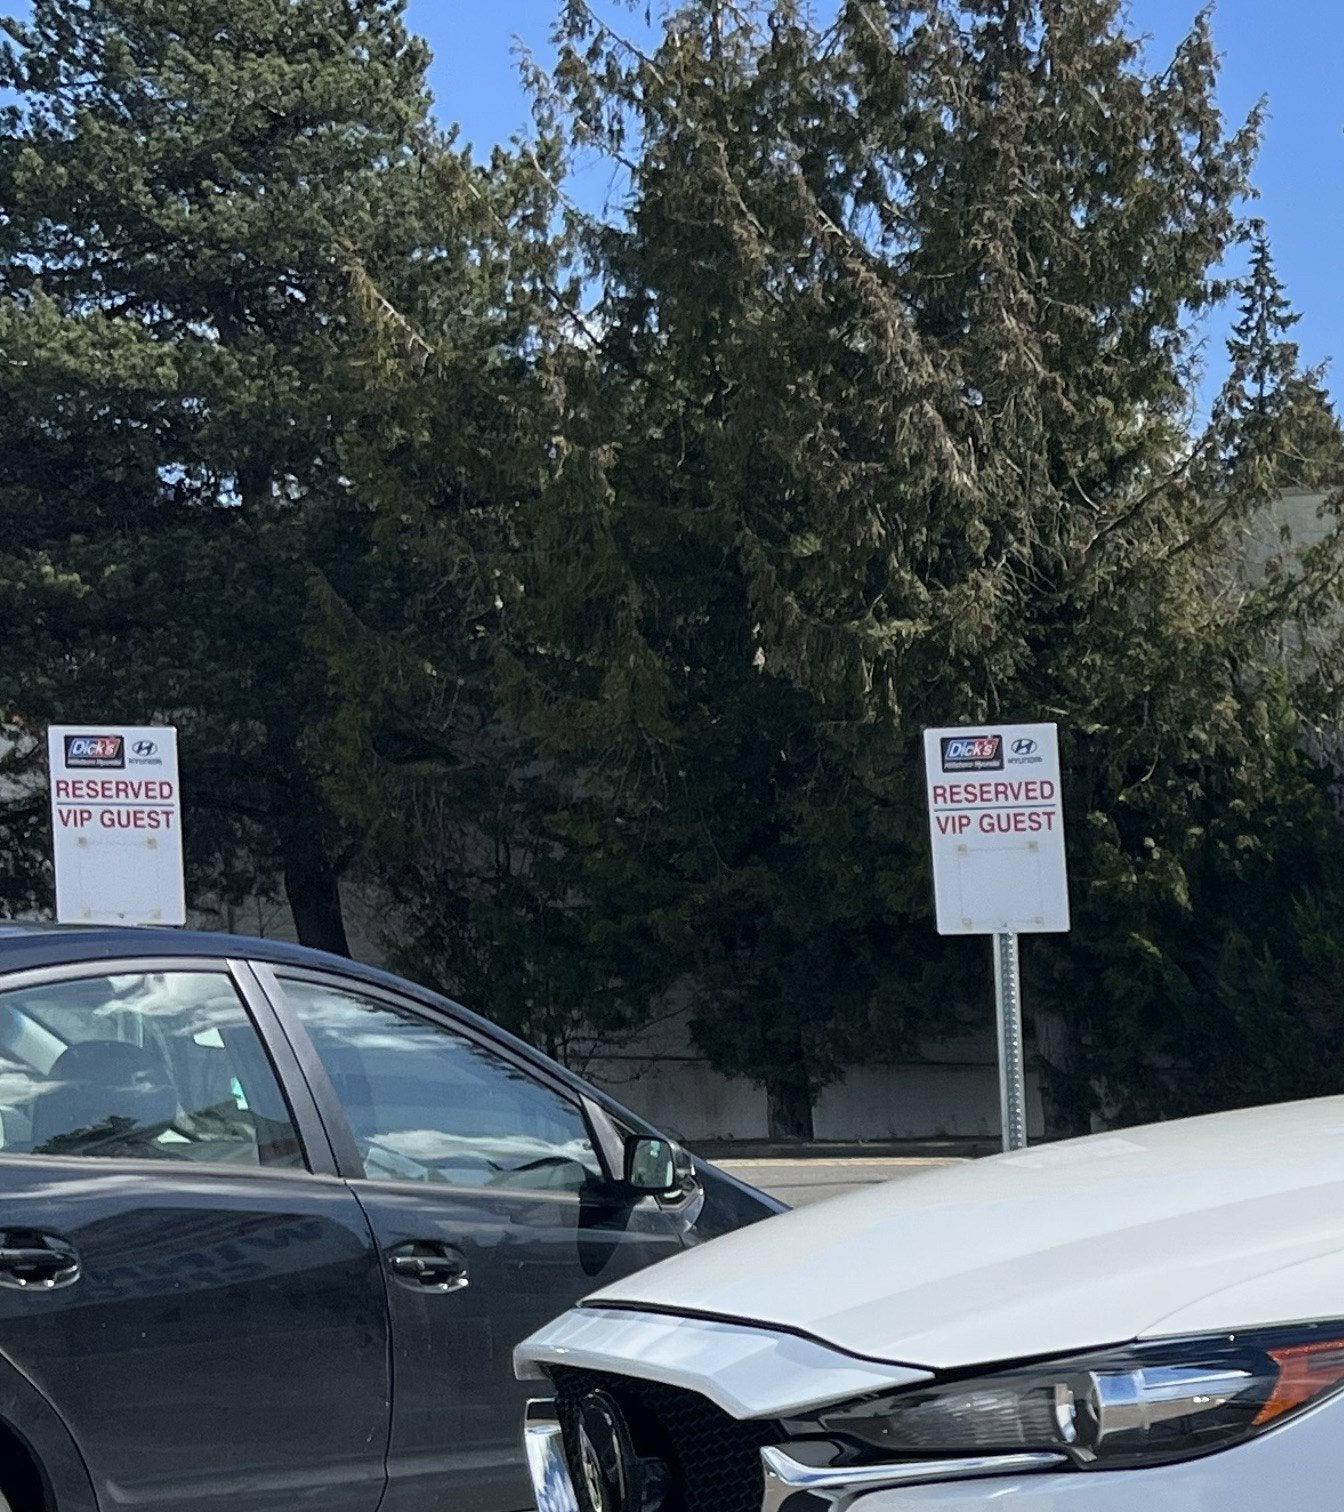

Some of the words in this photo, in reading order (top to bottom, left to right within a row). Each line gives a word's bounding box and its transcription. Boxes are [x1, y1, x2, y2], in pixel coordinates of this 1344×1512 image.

[55, 780, 173, 800] RESERVED
[933, 780, 1055, 804] RESERVED
[58, 809, 92, 828] VIP
[100, 809, 175, 829] GUEST
[936, 814, 971, 834] VIP
[979, 811, 1056, 833] GUEST
